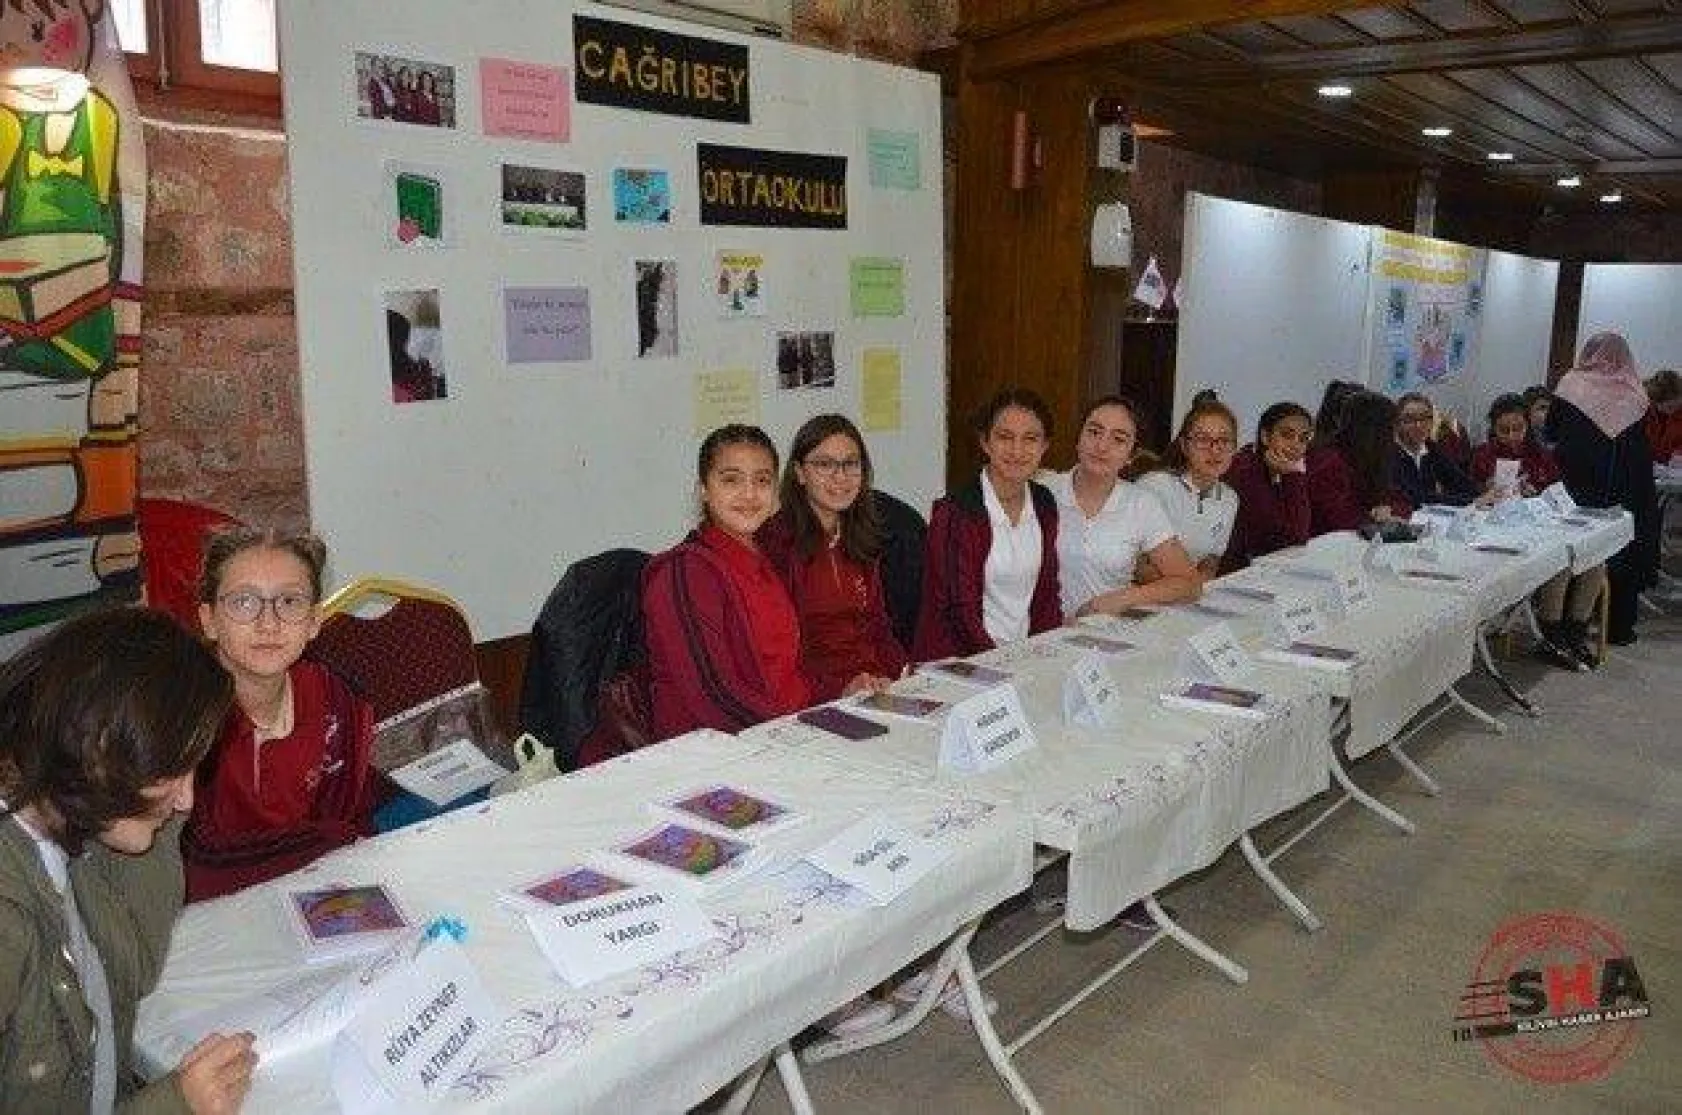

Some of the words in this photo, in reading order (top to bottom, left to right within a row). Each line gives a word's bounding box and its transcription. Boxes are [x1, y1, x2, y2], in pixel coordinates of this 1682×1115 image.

[702, 168, 847, 215] ORTAOKULU
[561, 892, 664, 928] DORUKHAN
[604, 921, 661, 945] YARGI
